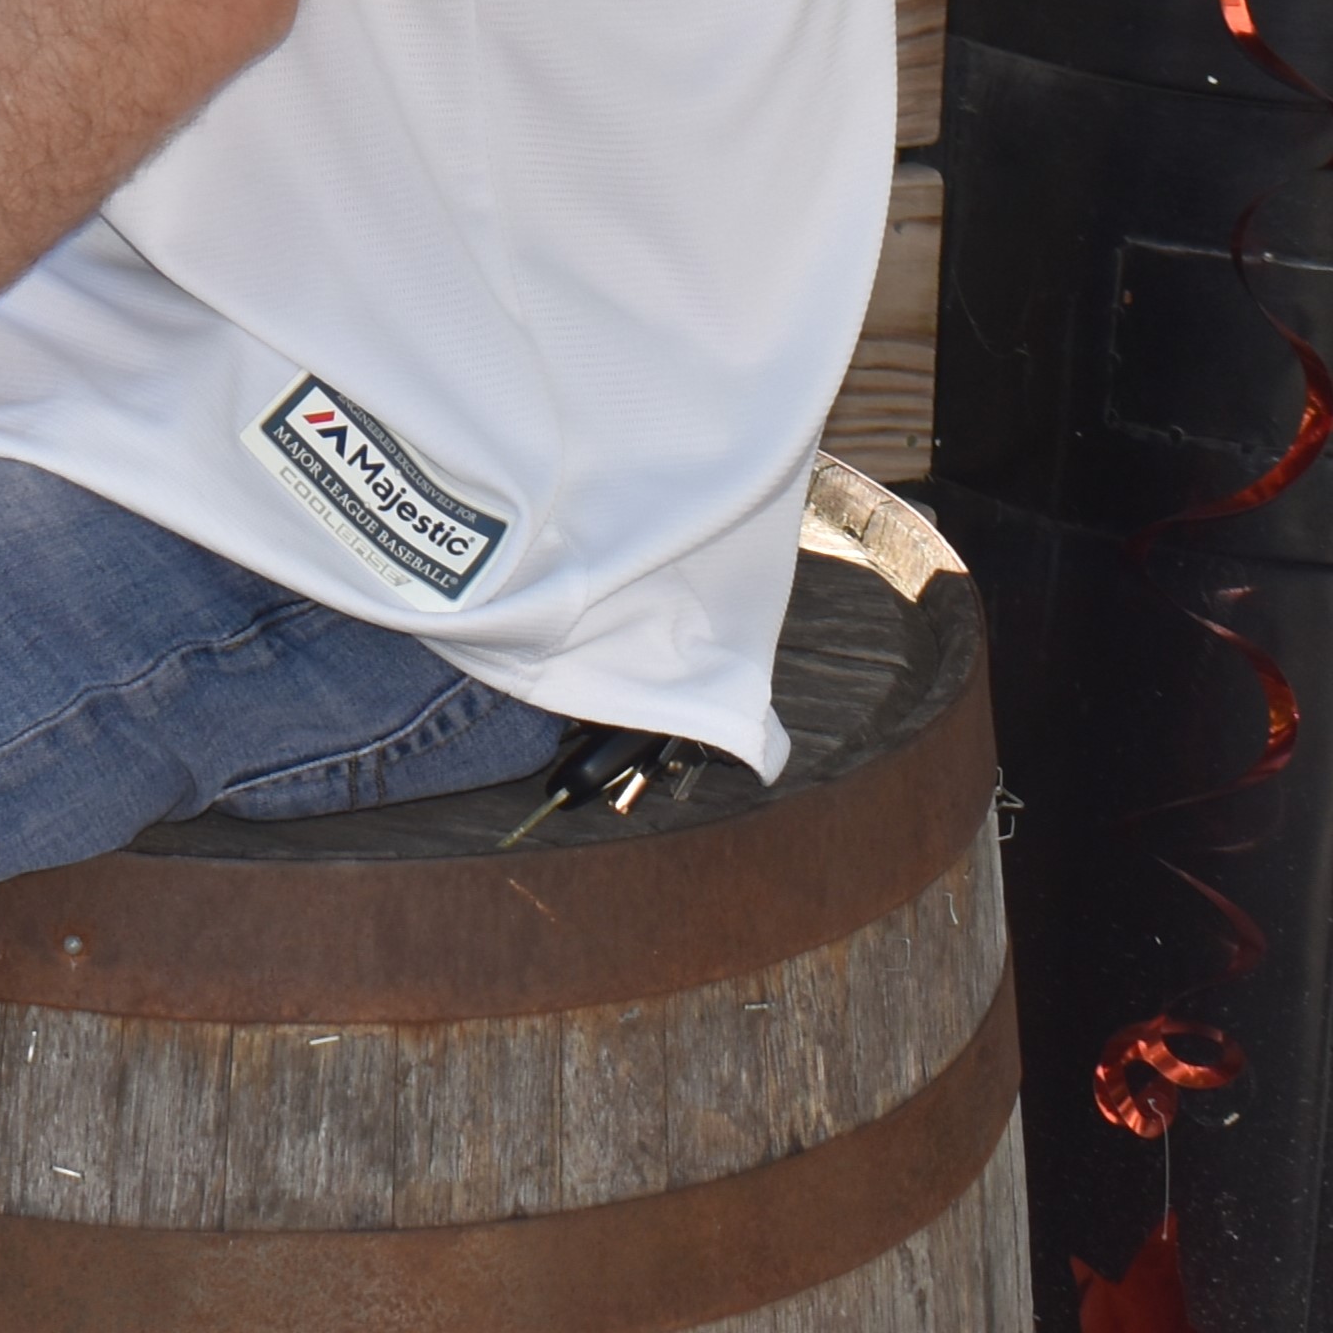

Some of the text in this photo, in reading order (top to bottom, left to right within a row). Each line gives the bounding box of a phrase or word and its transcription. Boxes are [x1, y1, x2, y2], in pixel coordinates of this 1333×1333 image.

[273, 425, 323, 480] MAJOR
[321, 472, 379, 534] LEAGUE
[347, 443, 470, 556] Majestic
[395, 451, 457, 510] EXCLUSIVELY
[455, 505, 478, 525] FOR
